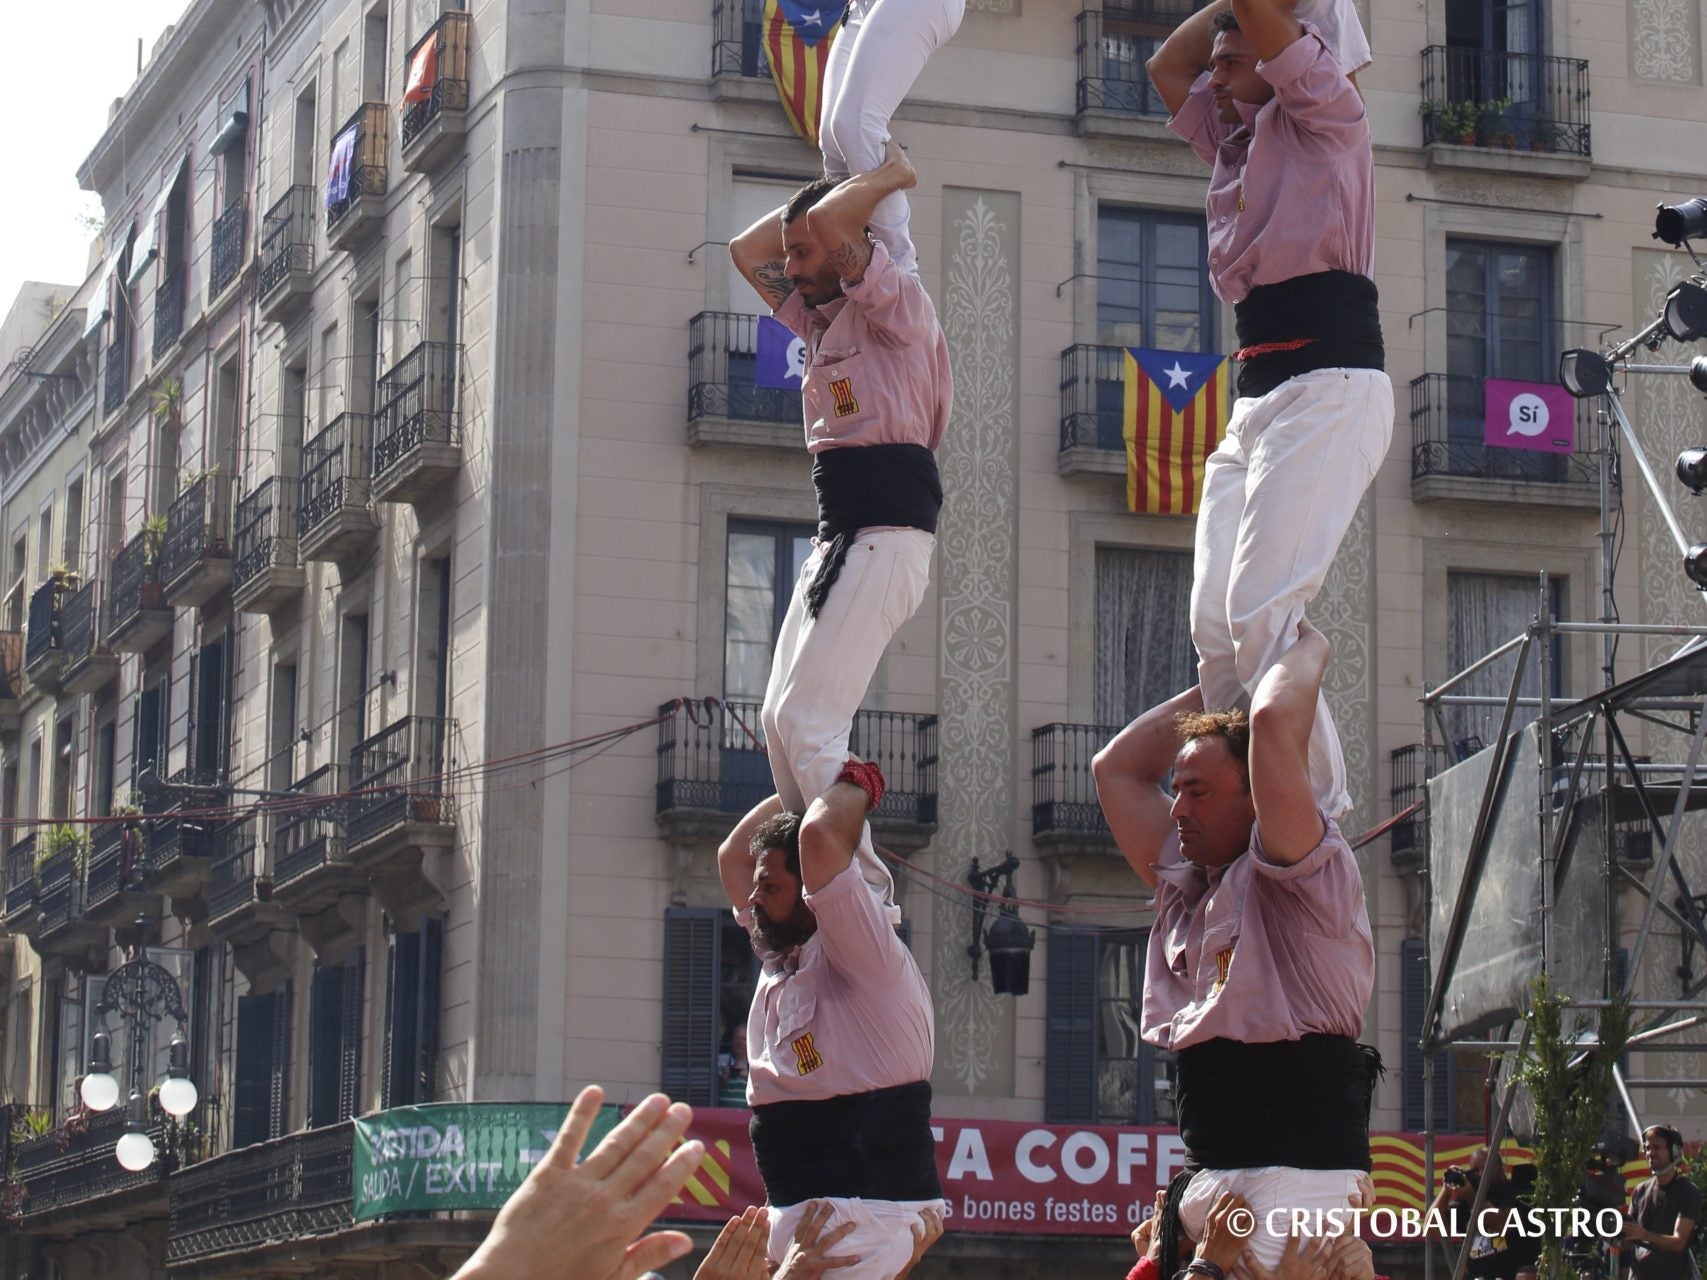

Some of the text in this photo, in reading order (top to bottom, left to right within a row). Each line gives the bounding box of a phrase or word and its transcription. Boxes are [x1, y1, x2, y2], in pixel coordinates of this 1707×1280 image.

[1519, 405, 1539, 423] Sí
[361, 1166, 402, 1203] SALIDA
[426, 1162, 502, 1194] EXIT
[963, 1195, 1036, 1220] bones
[1045, 1197, 1117, 1223] festes
